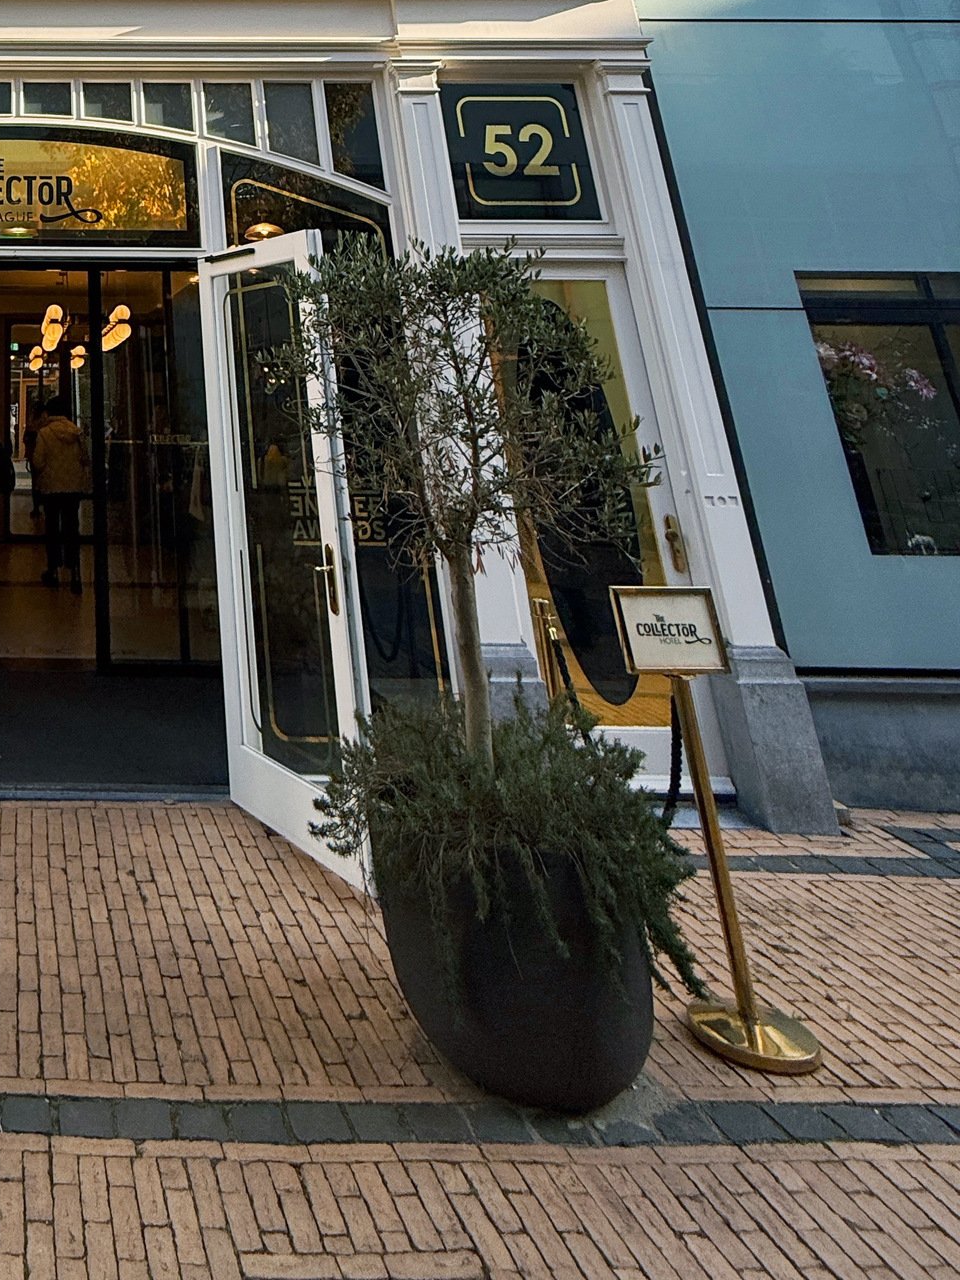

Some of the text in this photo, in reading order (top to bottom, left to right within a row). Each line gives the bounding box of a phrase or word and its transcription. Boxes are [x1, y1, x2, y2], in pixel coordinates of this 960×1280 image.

[483, 123, 560, 177] 52
[293, 519, 386, 540] AWDS
[636, 622, 712, 645] COLLECTOR
[659, 637, 682, 645] HOTEL
